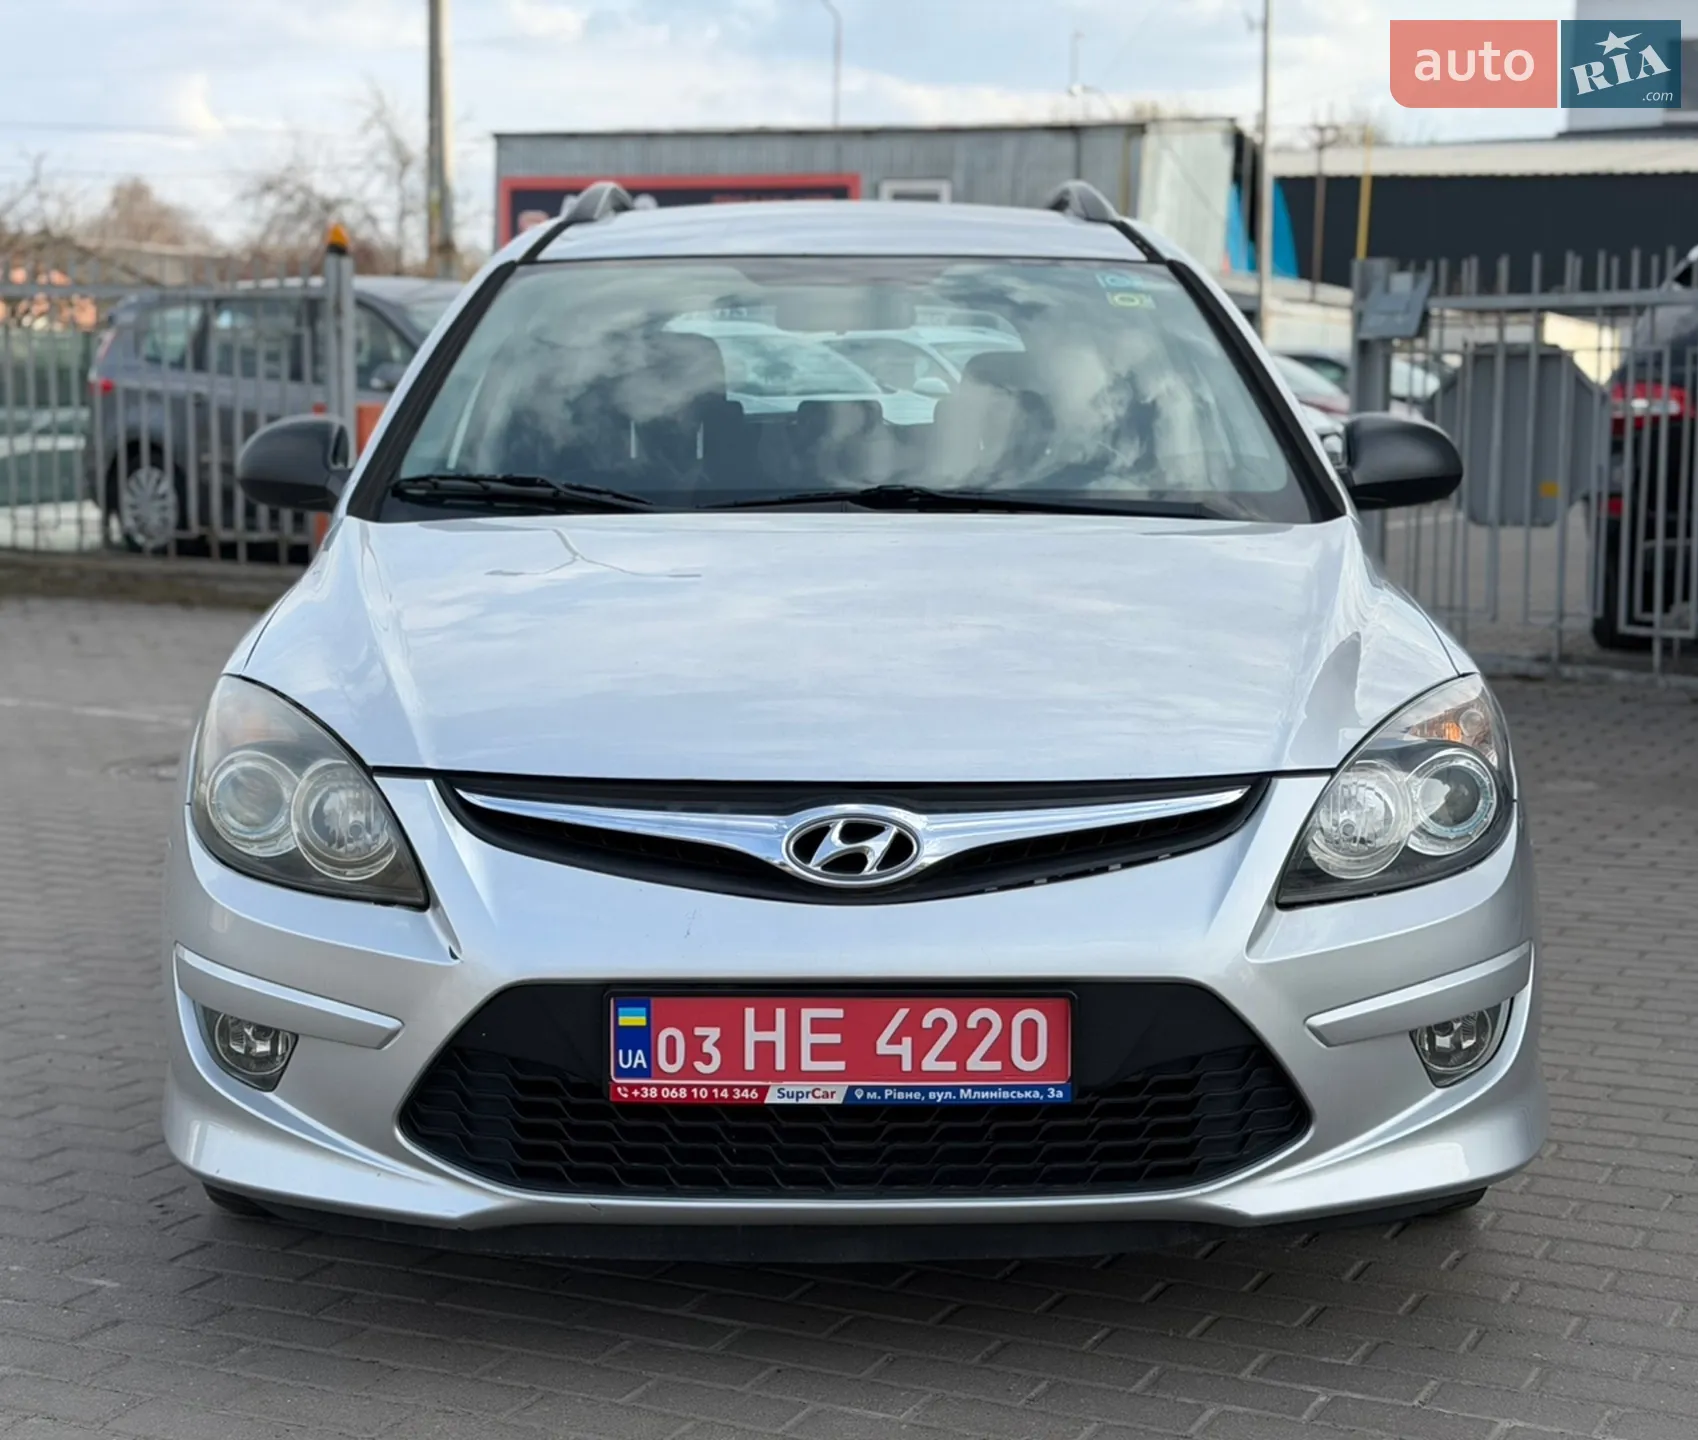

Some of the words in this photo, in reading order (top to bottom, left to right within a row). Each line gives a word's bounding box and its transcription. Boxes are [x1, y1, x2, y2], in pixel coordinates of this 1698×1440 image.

[657, 1026, 722, 1074] 03
[743, 1007, 846, 1072] HE
[875, 1007, 1048, 1072] 4220
[618, 1049, 648, 1069] UA
[631, 1086, 658, 1099] +38
[661, 1086, 688, 1099] 068
[691, 1086, 708, 1099] 10
[712, 1086, 729, 1099] 14
[732, 1087, 759, 1099] 346
[776, 1087, 837, 1103] SuprCar
[866, 1091, 881, 1100] м.
[884, 1088, 925, 1101] Рівне,
[928, 1090, 957, 1103] вул.
[959, 1087, 1044, 1101] Млинівська,
